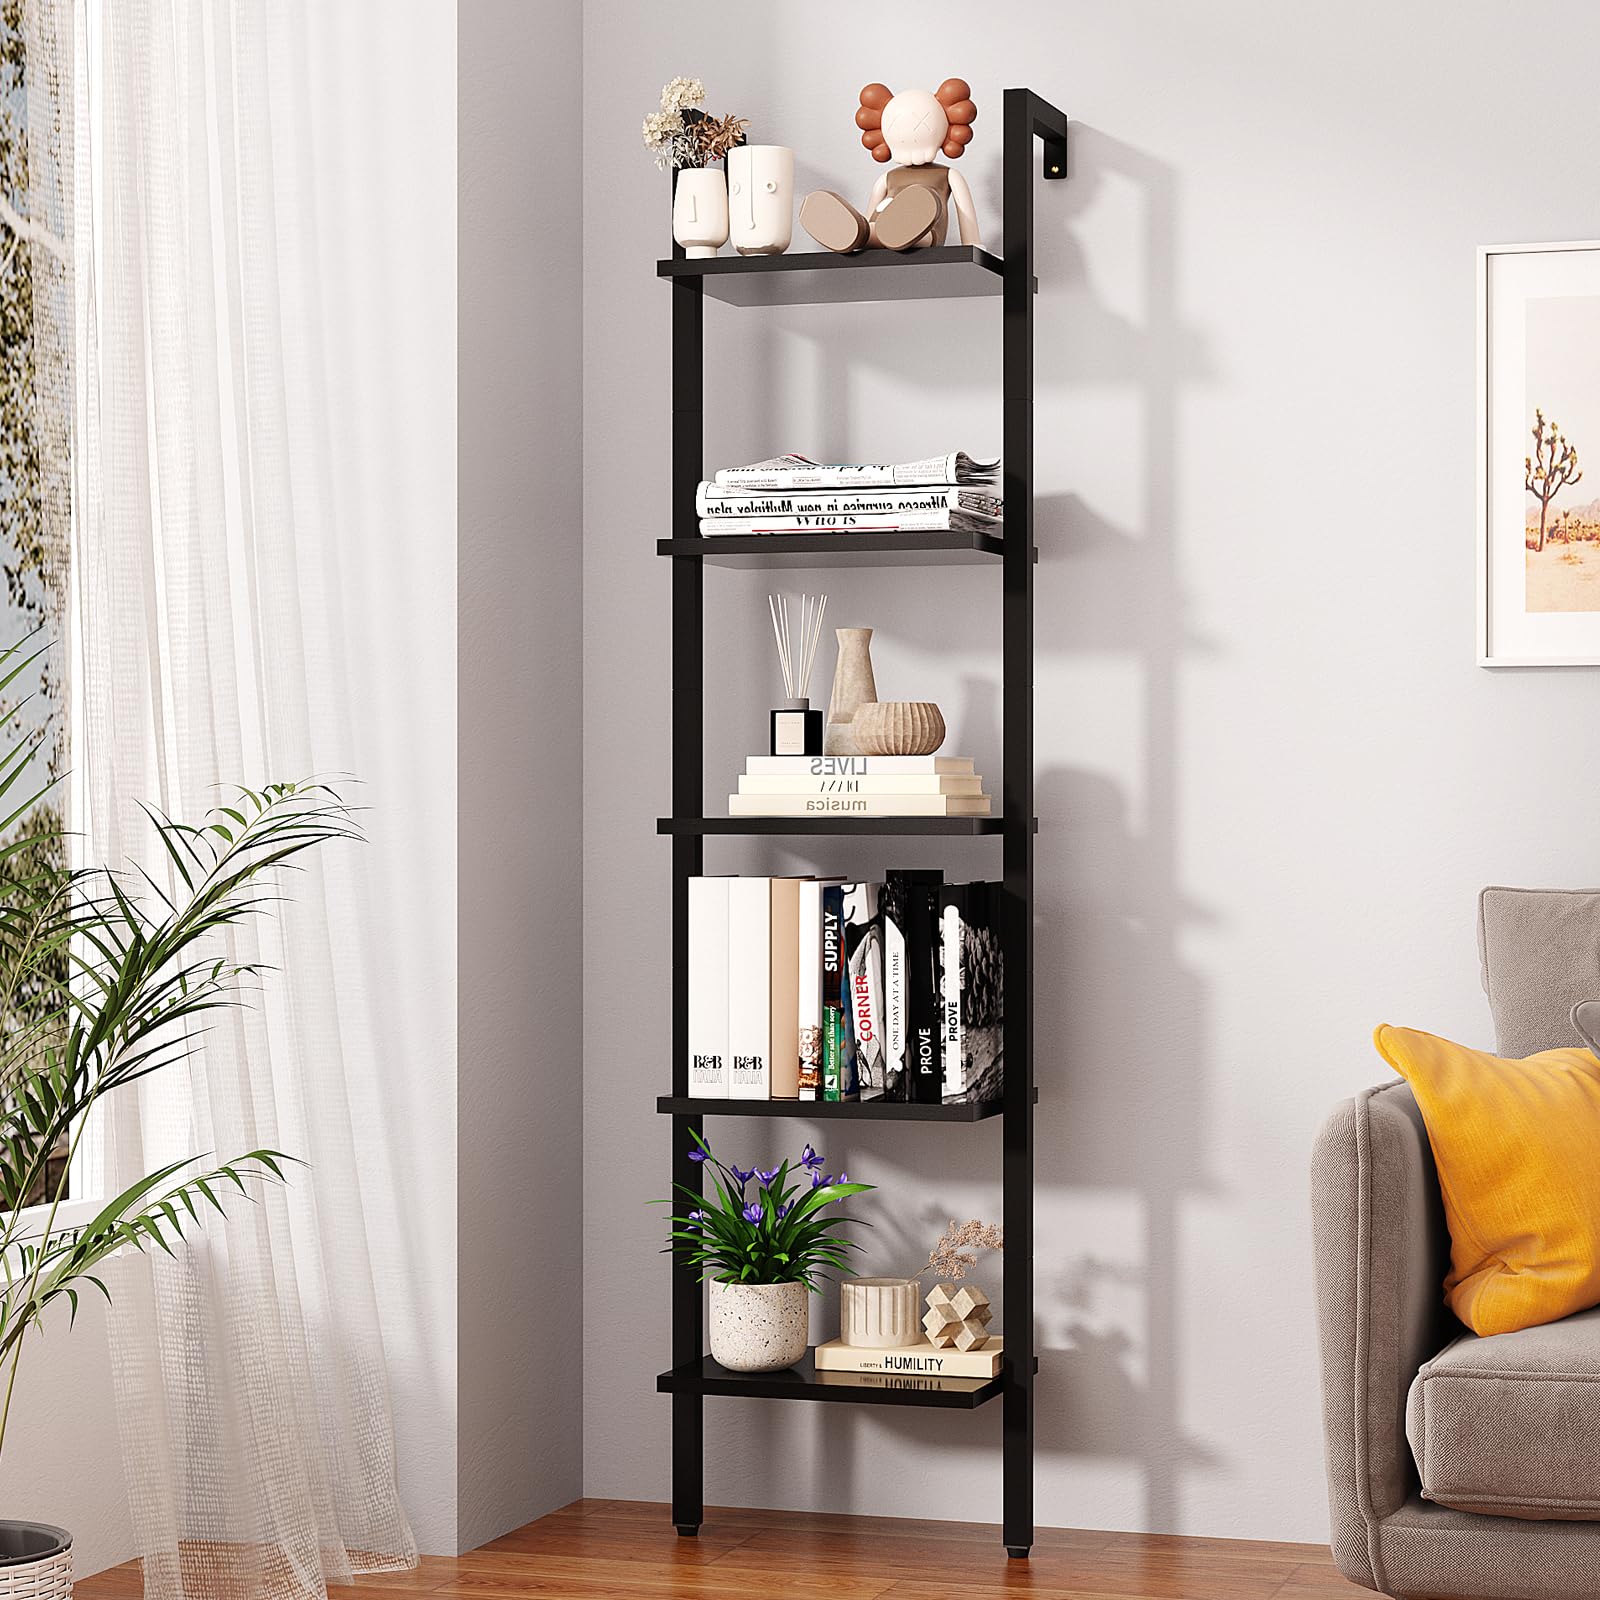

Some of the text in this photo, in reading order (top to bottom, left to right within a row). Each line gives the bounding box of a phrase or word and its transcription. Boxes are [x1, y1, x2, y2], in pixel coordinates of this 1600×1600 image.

[824, 911, 838, 972] SUPPLY
[892, 978, 899, 987] A
[892, 988, 899, 1002] AT
[855, 974, 873, 1042] CORNER
[948, 1001, 958, 1042] PROVE
[918, 1028, 932, 1074] PROVE
[693, 1055, 722, 1069] B&B
[733, 1056, 763, 1070] B&B
[885, 1356, 944, 1371] HUMILITY
